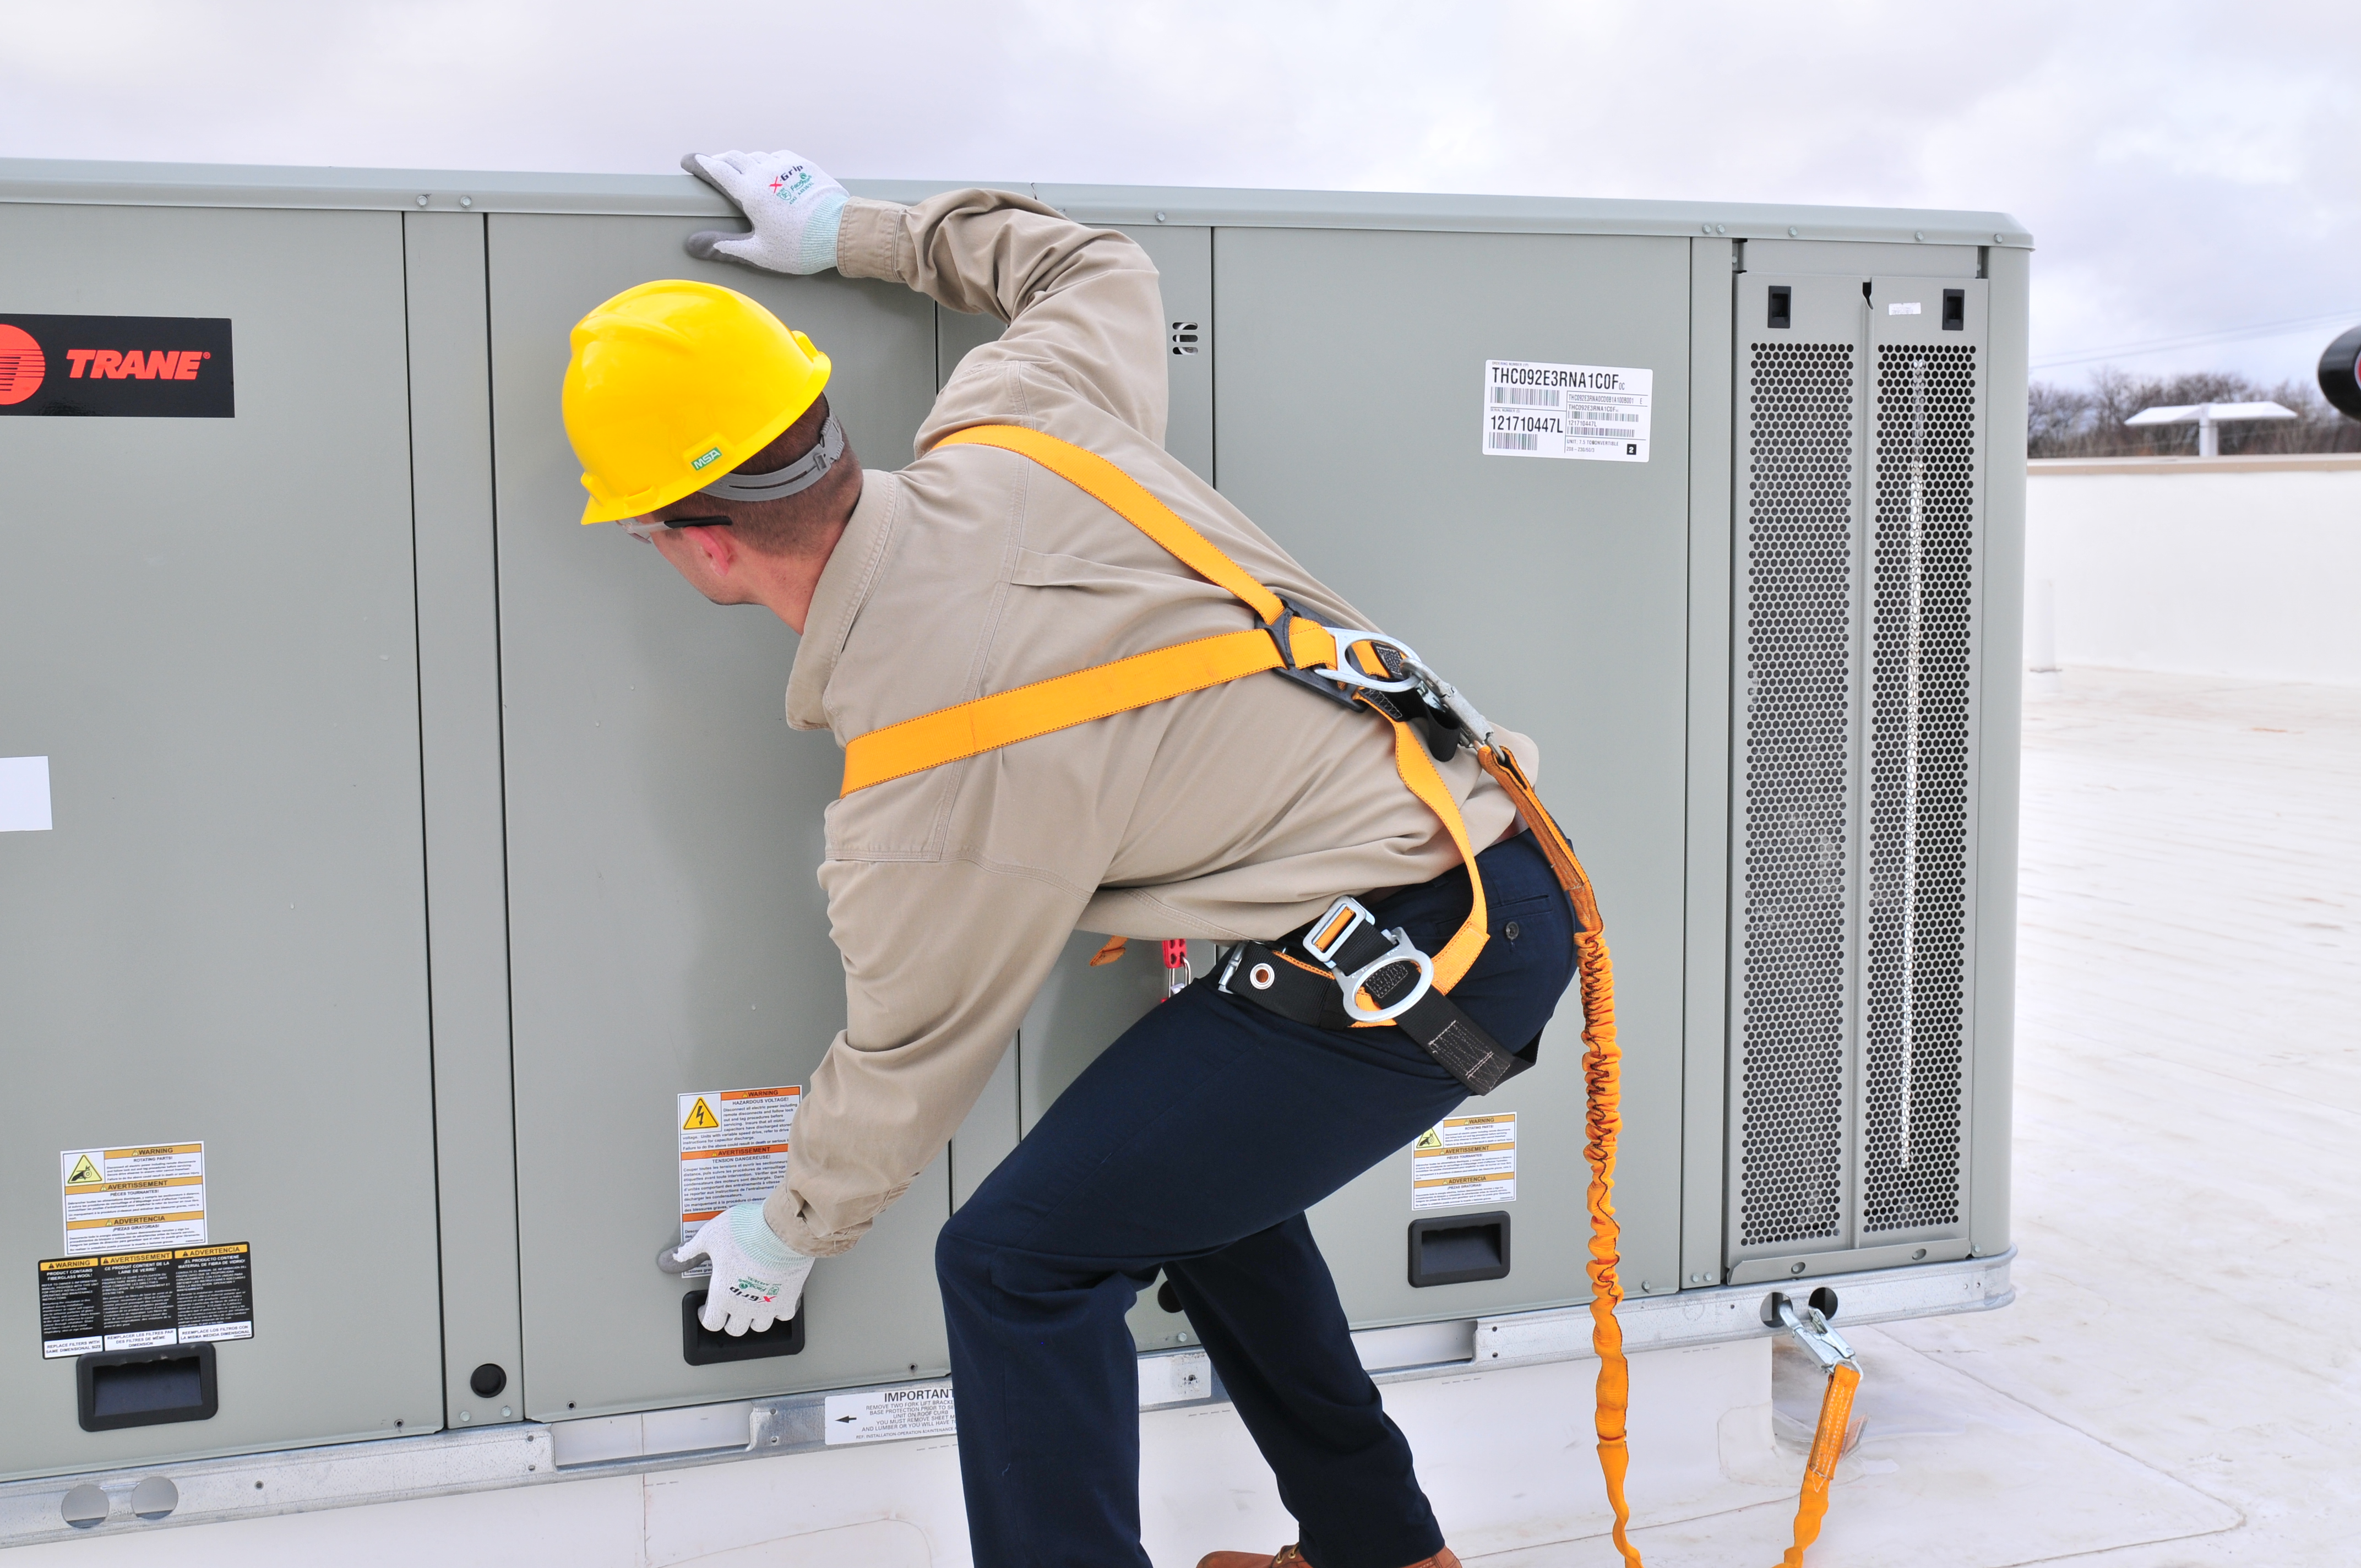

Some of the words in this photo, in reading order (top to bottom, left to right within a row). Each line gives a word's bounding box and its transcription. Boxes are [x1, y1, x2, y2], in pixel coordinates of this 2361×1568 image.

[66, 349, 203, 380] TRANE
[1492, 368, 1619, 389] THC092E3RNA1C0F
[1491, 415, 1563, 433] 121710447L
[694, 449, 721, 469] MSA
[718, 1147, 770, 1156] AVERTISSEMENT
[108, 1180, 168, 1190] AVERTISSEMENT
[114, 1215, 165, 1225] ADVERTENCIA
[189, 1246, 240, 1256] ADVERTENCIA
[110, 1253, 170, 1263] AVERTISSEMENT
[56, 1260, 90, 1268] WARNING
